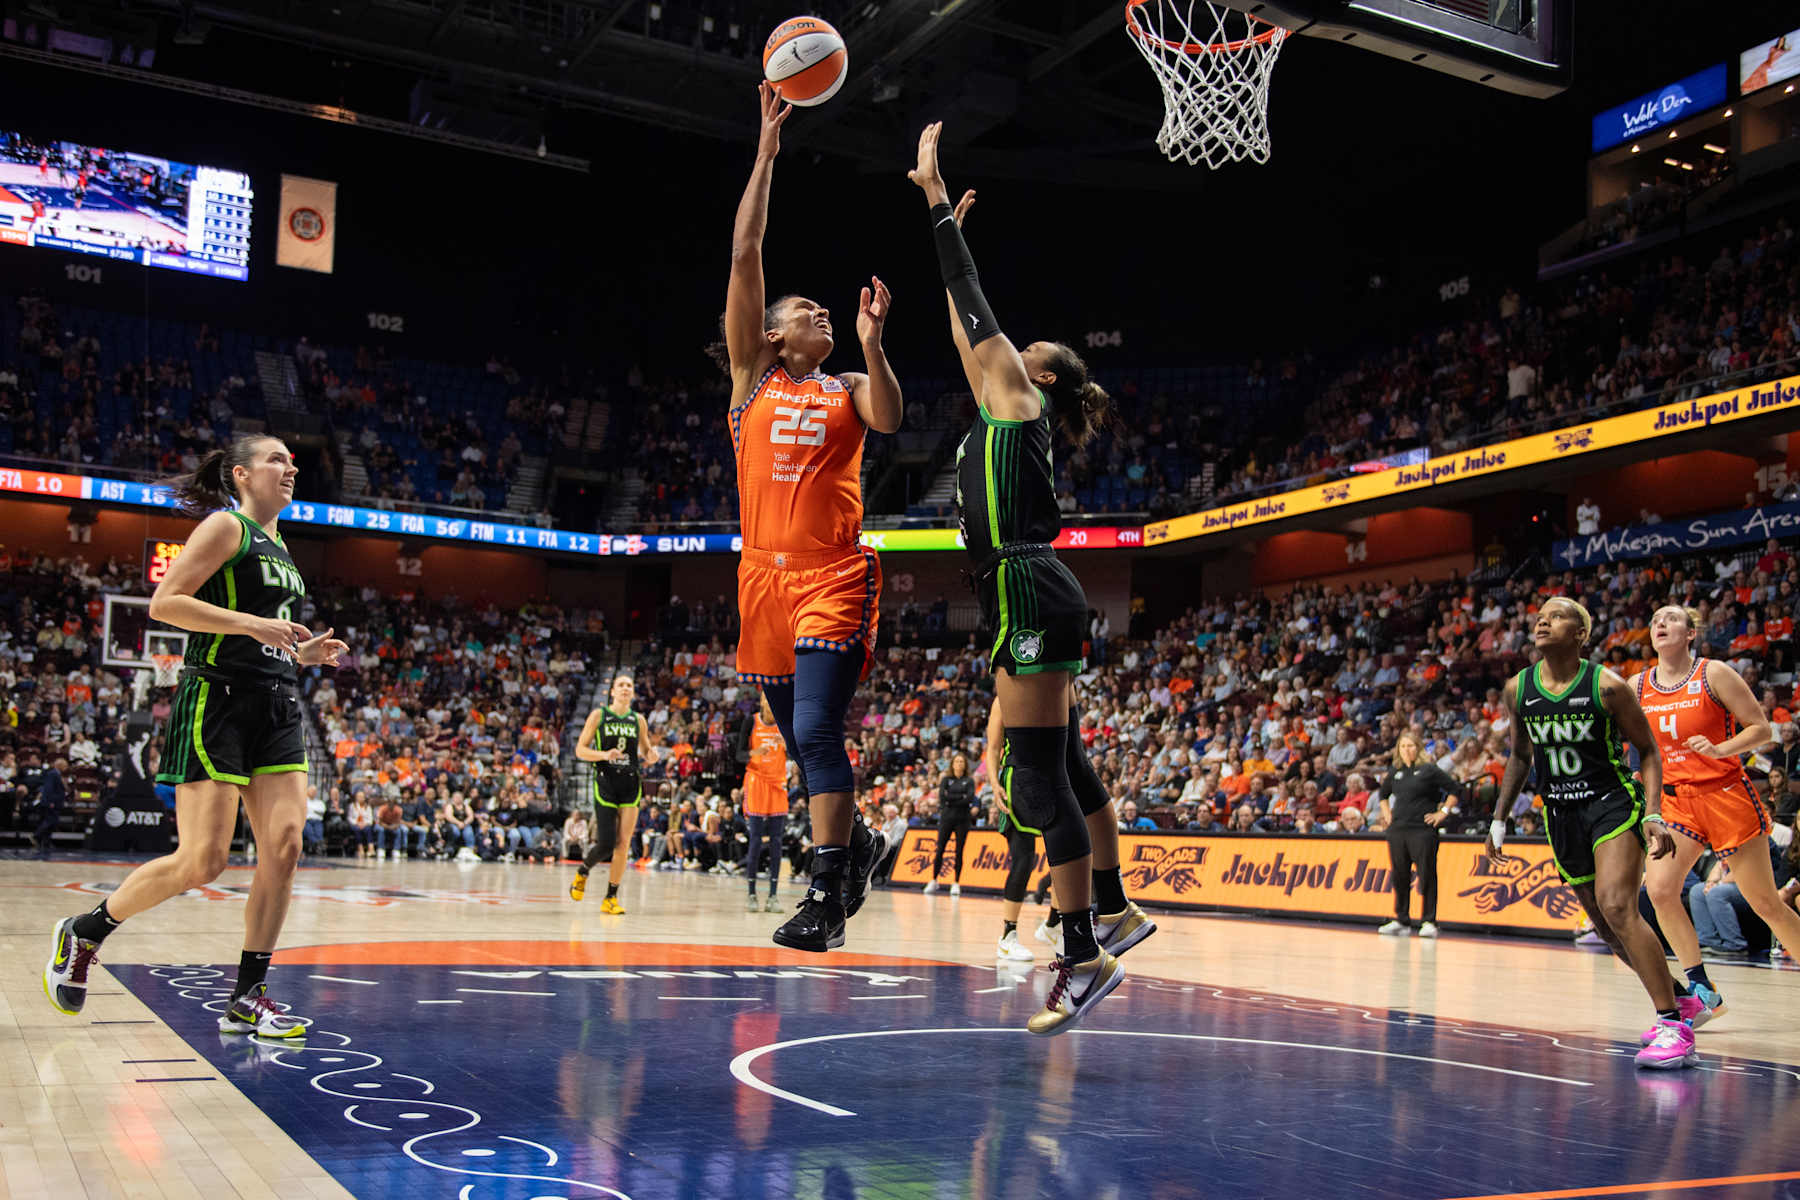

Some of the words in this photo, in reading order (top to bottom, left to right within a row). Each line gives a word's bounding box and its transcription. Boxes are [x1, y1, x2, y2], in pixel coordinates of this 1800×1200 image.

[1622, 101, 1659, 129] Wolf
[1662, 94, 1693, 113] Den
[64, 264, 102, 284] 101
[1439, 276, 1470, 301] 105
[367, 312, 404, 333] 102
[1085, 330, 1122, 348] 104
[763, 388, 843, 408] CONNECTICUT
[1654, 395, 1739, 431] Jackpot
[770, 405, 829, 447] 25
[774, 451, 791, 463] Yale
[1395, 460, 1455, 487] Jackpot
[1461, 448, 1506, 473] Juice
[0, 470, 23, 489] FTA
[36, 476, 63, 493] 10
[1754, 463, 1788, 493] 15
[100, 481, 127, 501] AST
[291, 504, 315, 521] 13
[327, 506, 355, 525] FGM
[366, 513, 391, 529] 25
[401, 515, 425, 533] FGA
[436, 520, 460, 537] 56
[470, 522, 494, 541] FTM
[505, 529, 527, 545] 11
[538, 531, 558, 548] FTA
[568, 536, 590, 552] 12
[1069, 531, 1088, 546] 20
[1117, 531, 1141, 545] 4TH
[657, 537, 706, 552] SUN
[1584, 529, 1682, 562] Mohegan
[1686, 521, 1738, 548] Sun
[396, 557, 423, 577] 12
[889, 573, 915, 592] 13
[1523, 713, 1594, 721] MINNESOTA
[1658, 713, 1679, 740] 4
[604, 725, 638, 739] LYNX
[1525, 719, 1596, 745] LYNX
[617, 736, 628, 752] 8
[1543, 745, 1583, 777] 10
[1548, 780, 1589, 793] MAYO
[126, 811, 164, 826] AT&T
[1140, 847, 1165, 862] TWO
[1157, 848, 1198, 877] ROADS
[1221, 852, 1340, 897] Jackpot
[1343, 858, 1422, 895] Jui
[1516, 861, 1560, 897] ROA
